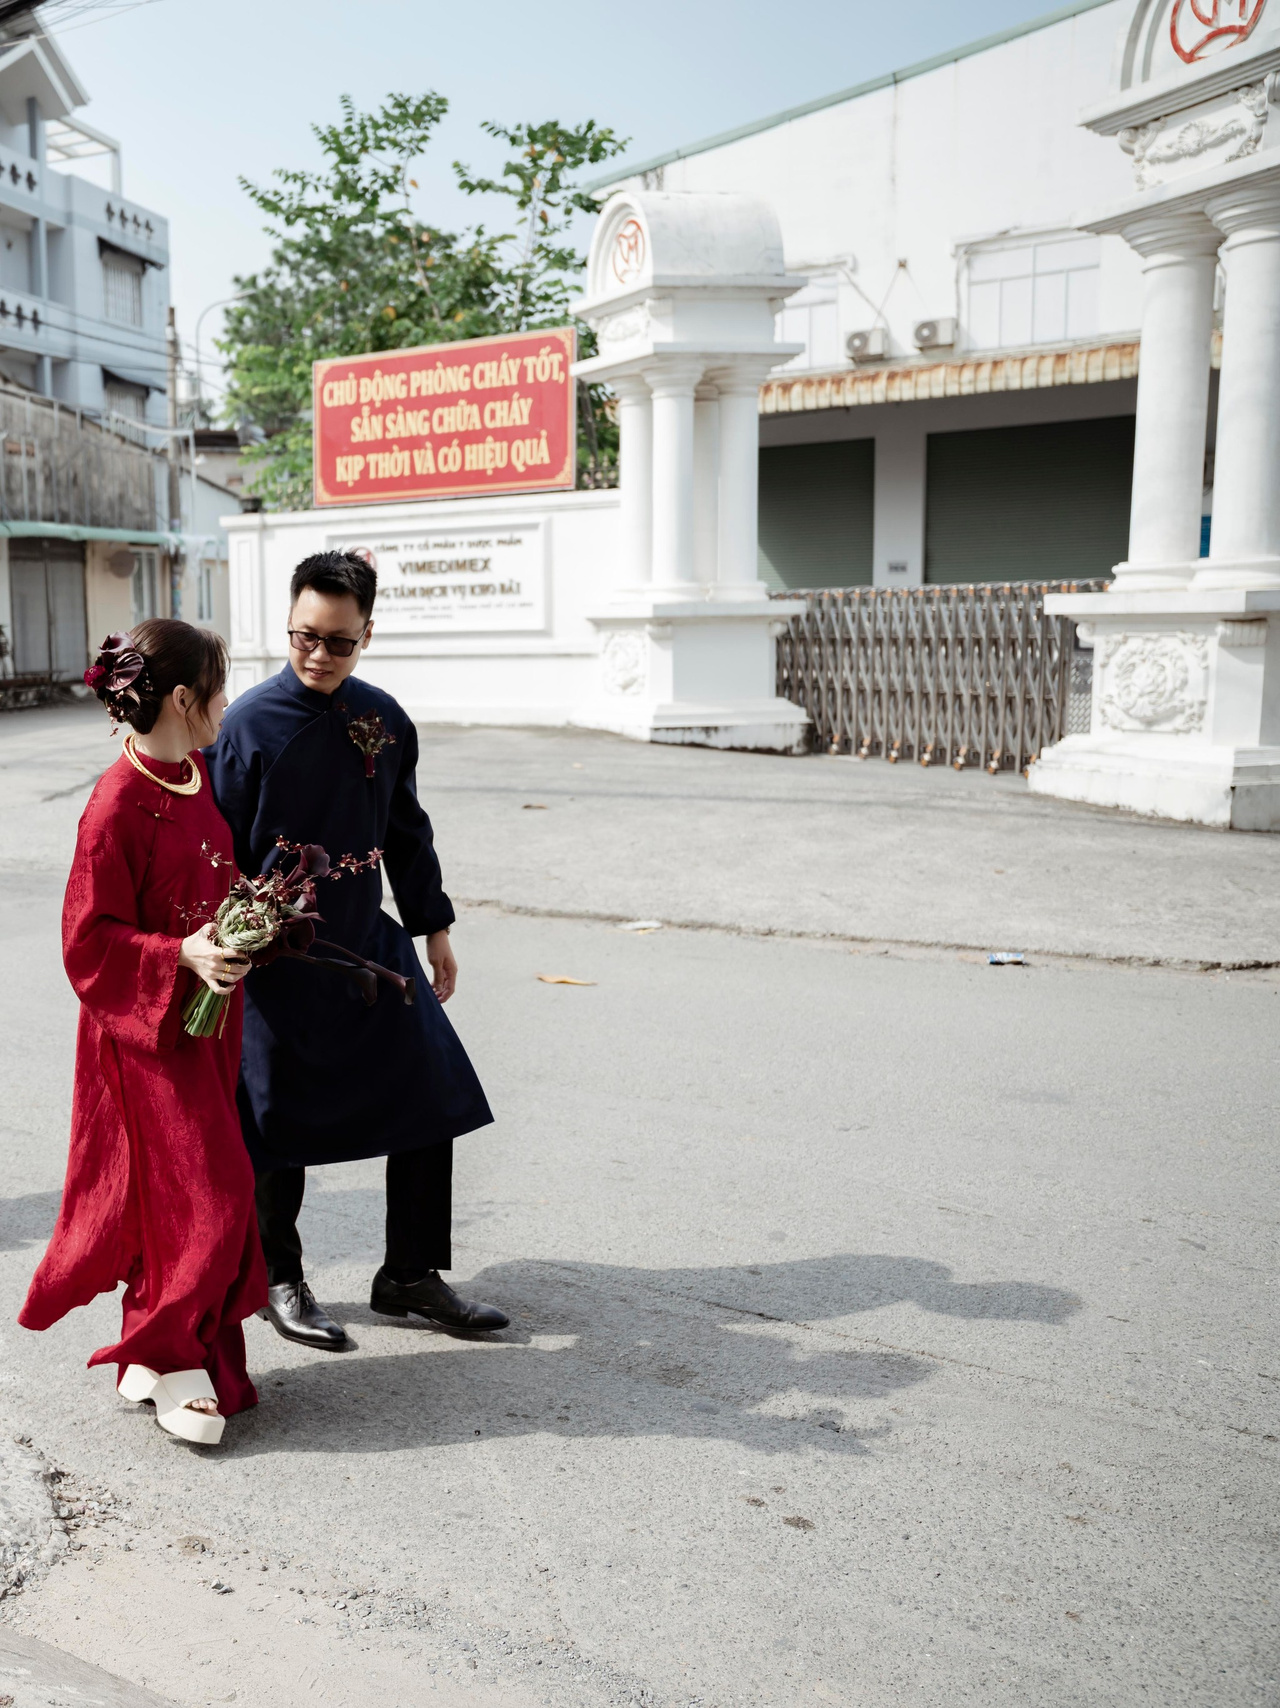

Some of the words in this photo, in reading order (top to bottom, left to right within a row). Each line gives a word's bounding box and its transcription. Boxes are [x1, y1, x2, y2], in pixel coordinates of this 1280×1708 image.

[323, 372, 357, 408] CHỦ
[359, 369, 408, 409] ĐỘNG
[410, 361, 471, 398] PHÒNG
[472, 352, 522, 390] CHÁY
[523, 345, 566, 384] TỐT,
[350, 405, 383, 443] SẴN
[385, 405, 430, 440] SÀNG
[432, 398, 481, 435] CHỮA
[484, 391, 533, 429] CHÁY
[335, 454, 365, 488] KỊP
[367, 444, 410, 480] THỜI
[413, 441, 436, 475] VÀ
[437, 438, 462, 474] CÓ
[464, 435, 508, 476] HIỆU
[510, 429, 550, 473] QUẢ
[398, 557, 493, 576] VIMEDIMEX
